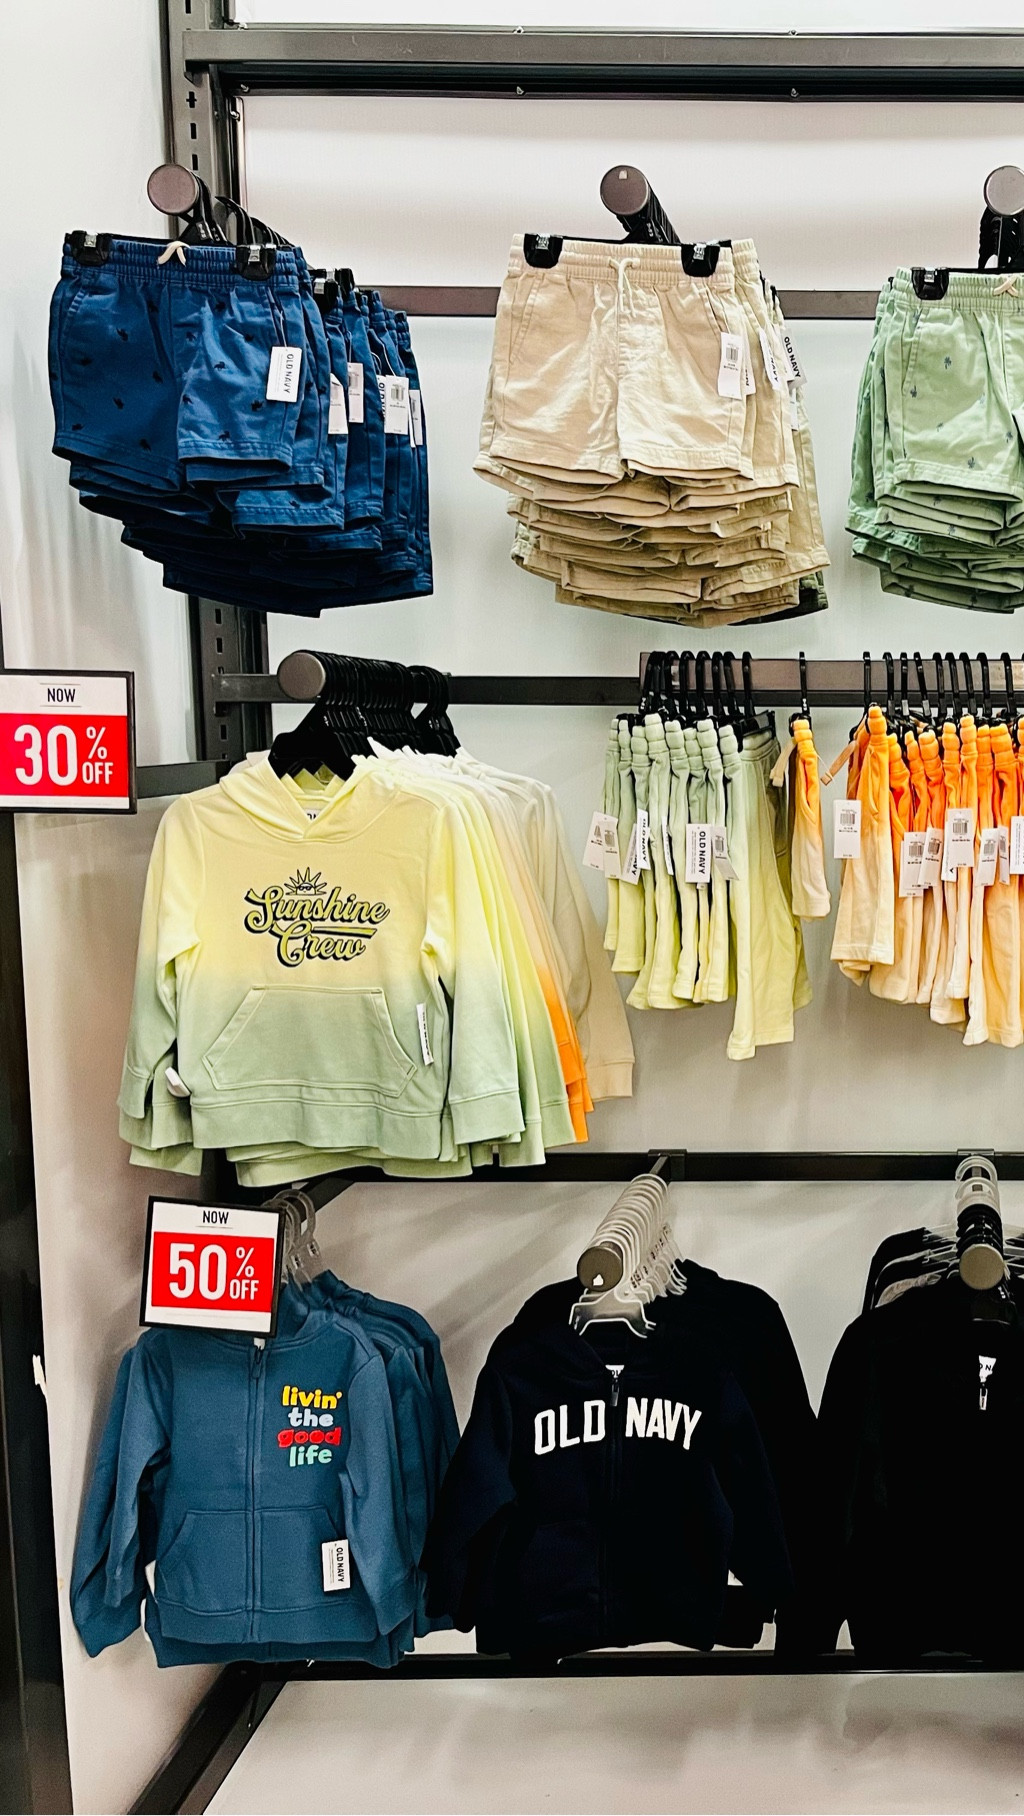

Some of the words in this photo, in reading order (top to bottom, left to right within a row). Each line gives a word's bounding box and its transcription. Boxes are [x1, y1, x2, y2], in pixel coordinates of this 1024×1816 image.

[286, 353, 294, 370] OLD
[783, 336, 793, 353] OLD
[789, 354, 801, 378] NAVY
[283, 371, 292, 394] NAVY
[47, 687, 76, 703] NOW
[14, 723, 78, 787] 30
[81, 761, 114, 785] OFF
[244, 885, 390, 934] Sunshine
[269, 920, 366, 968] Crew
[202, 1210, 229, 1224] NOW
[169, 1242, 227, 1301] 50
[229, 1279, 260, 1301] OFF
[281, 1385, 343, 1409] livin'
[288, 1407, 334, 1427] the
[534, 1400, 606, 1455] OLD
[625, 1397, 702, 1450] NAVY
[277, 1427, 342, 1448] good
[289, 1445, 333, 1467] life
[336, 1547, 344, 1562] OLD
[337, 1562, 345, 1582] NAVY
